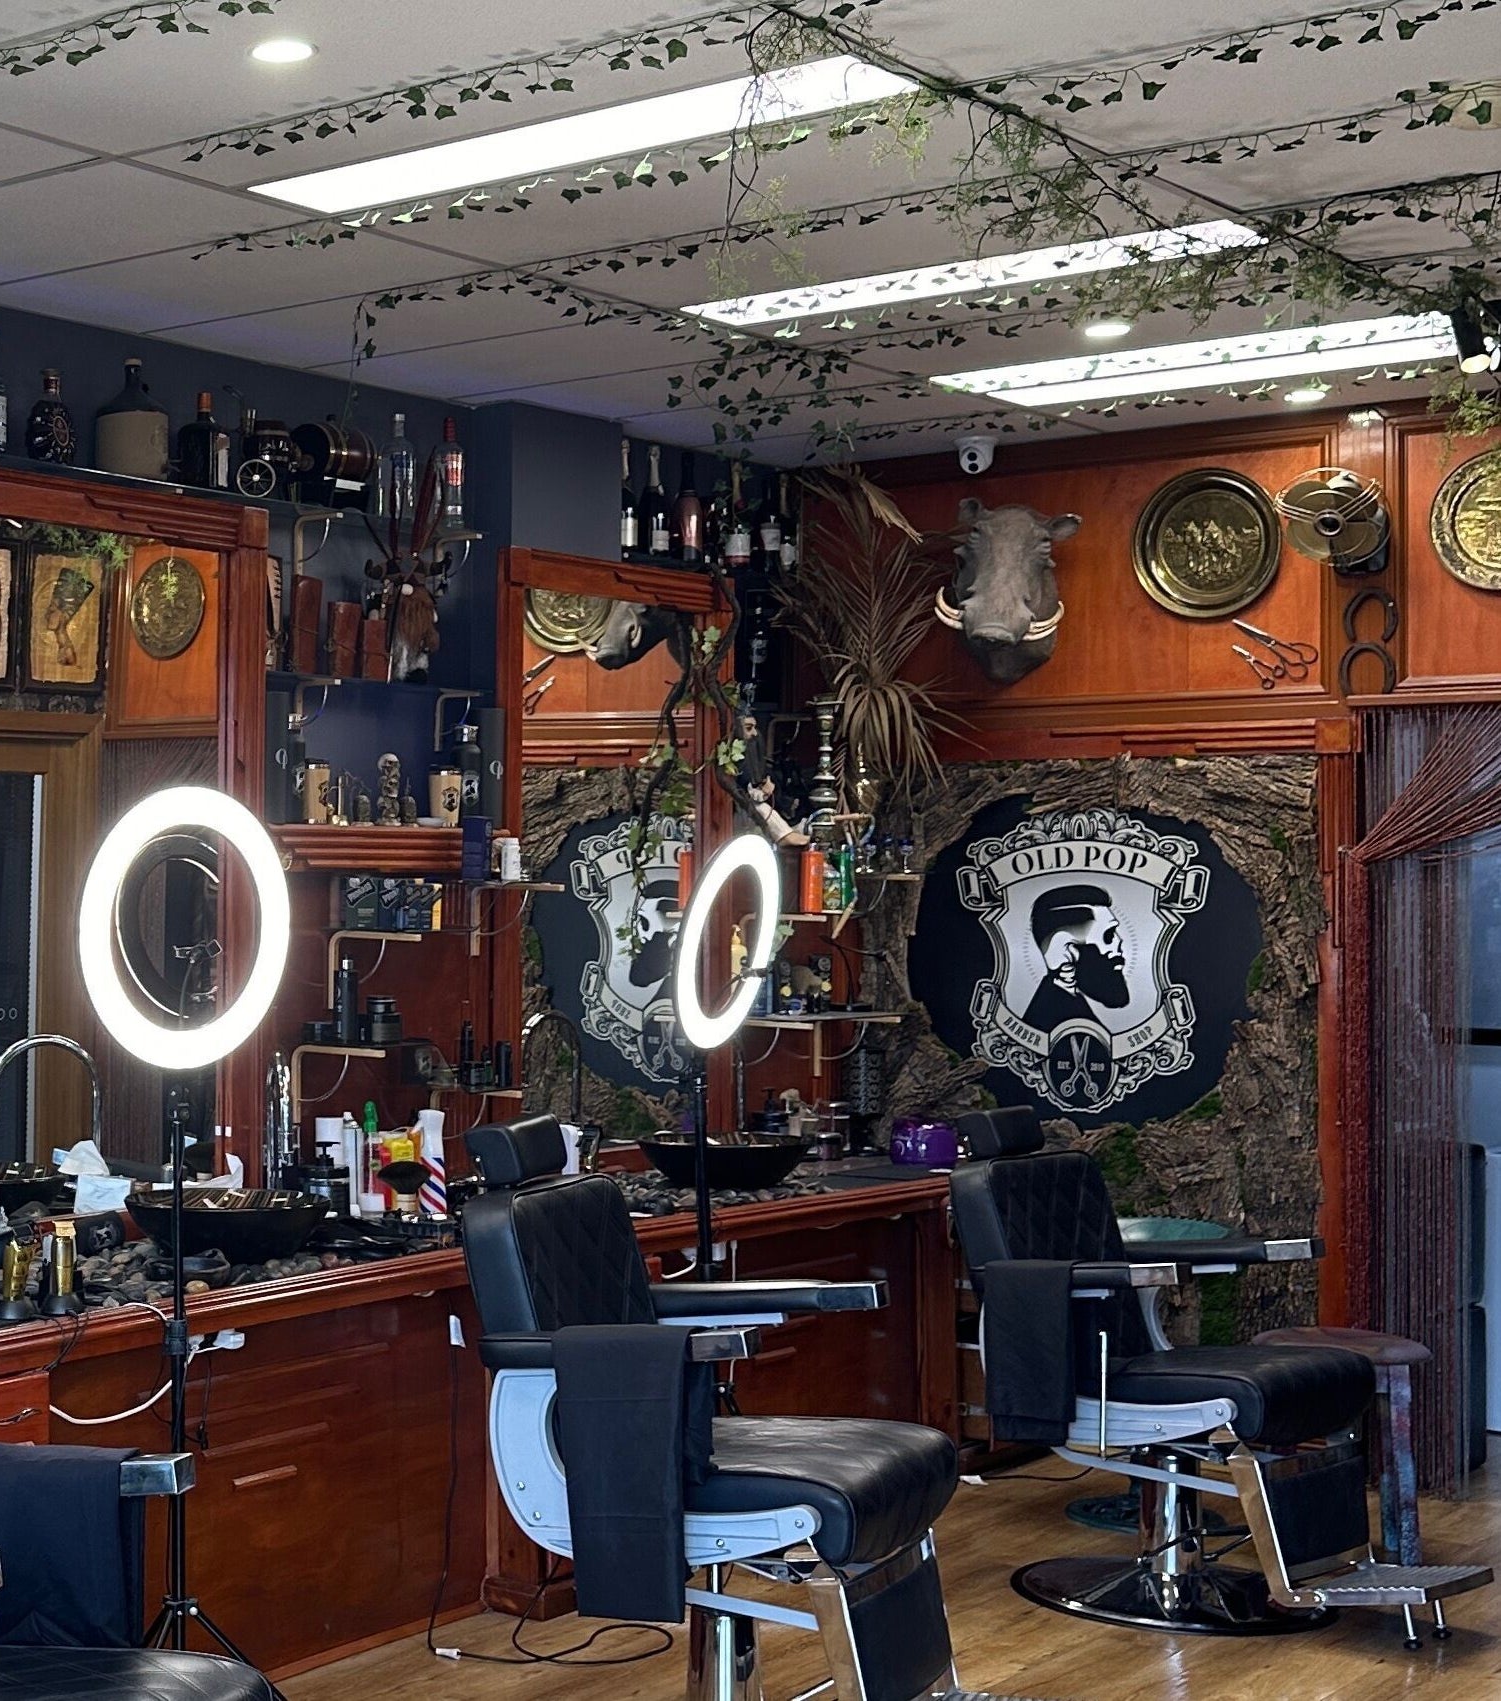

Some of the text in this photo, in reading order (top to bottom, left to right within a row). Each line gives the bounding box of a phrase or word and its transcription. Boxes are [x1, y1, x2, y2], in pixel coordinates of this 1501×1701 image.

[1011, 845, 1148, 876] OLD POP
[1002, 1015, 1153, 1049] BARBER SHOP
